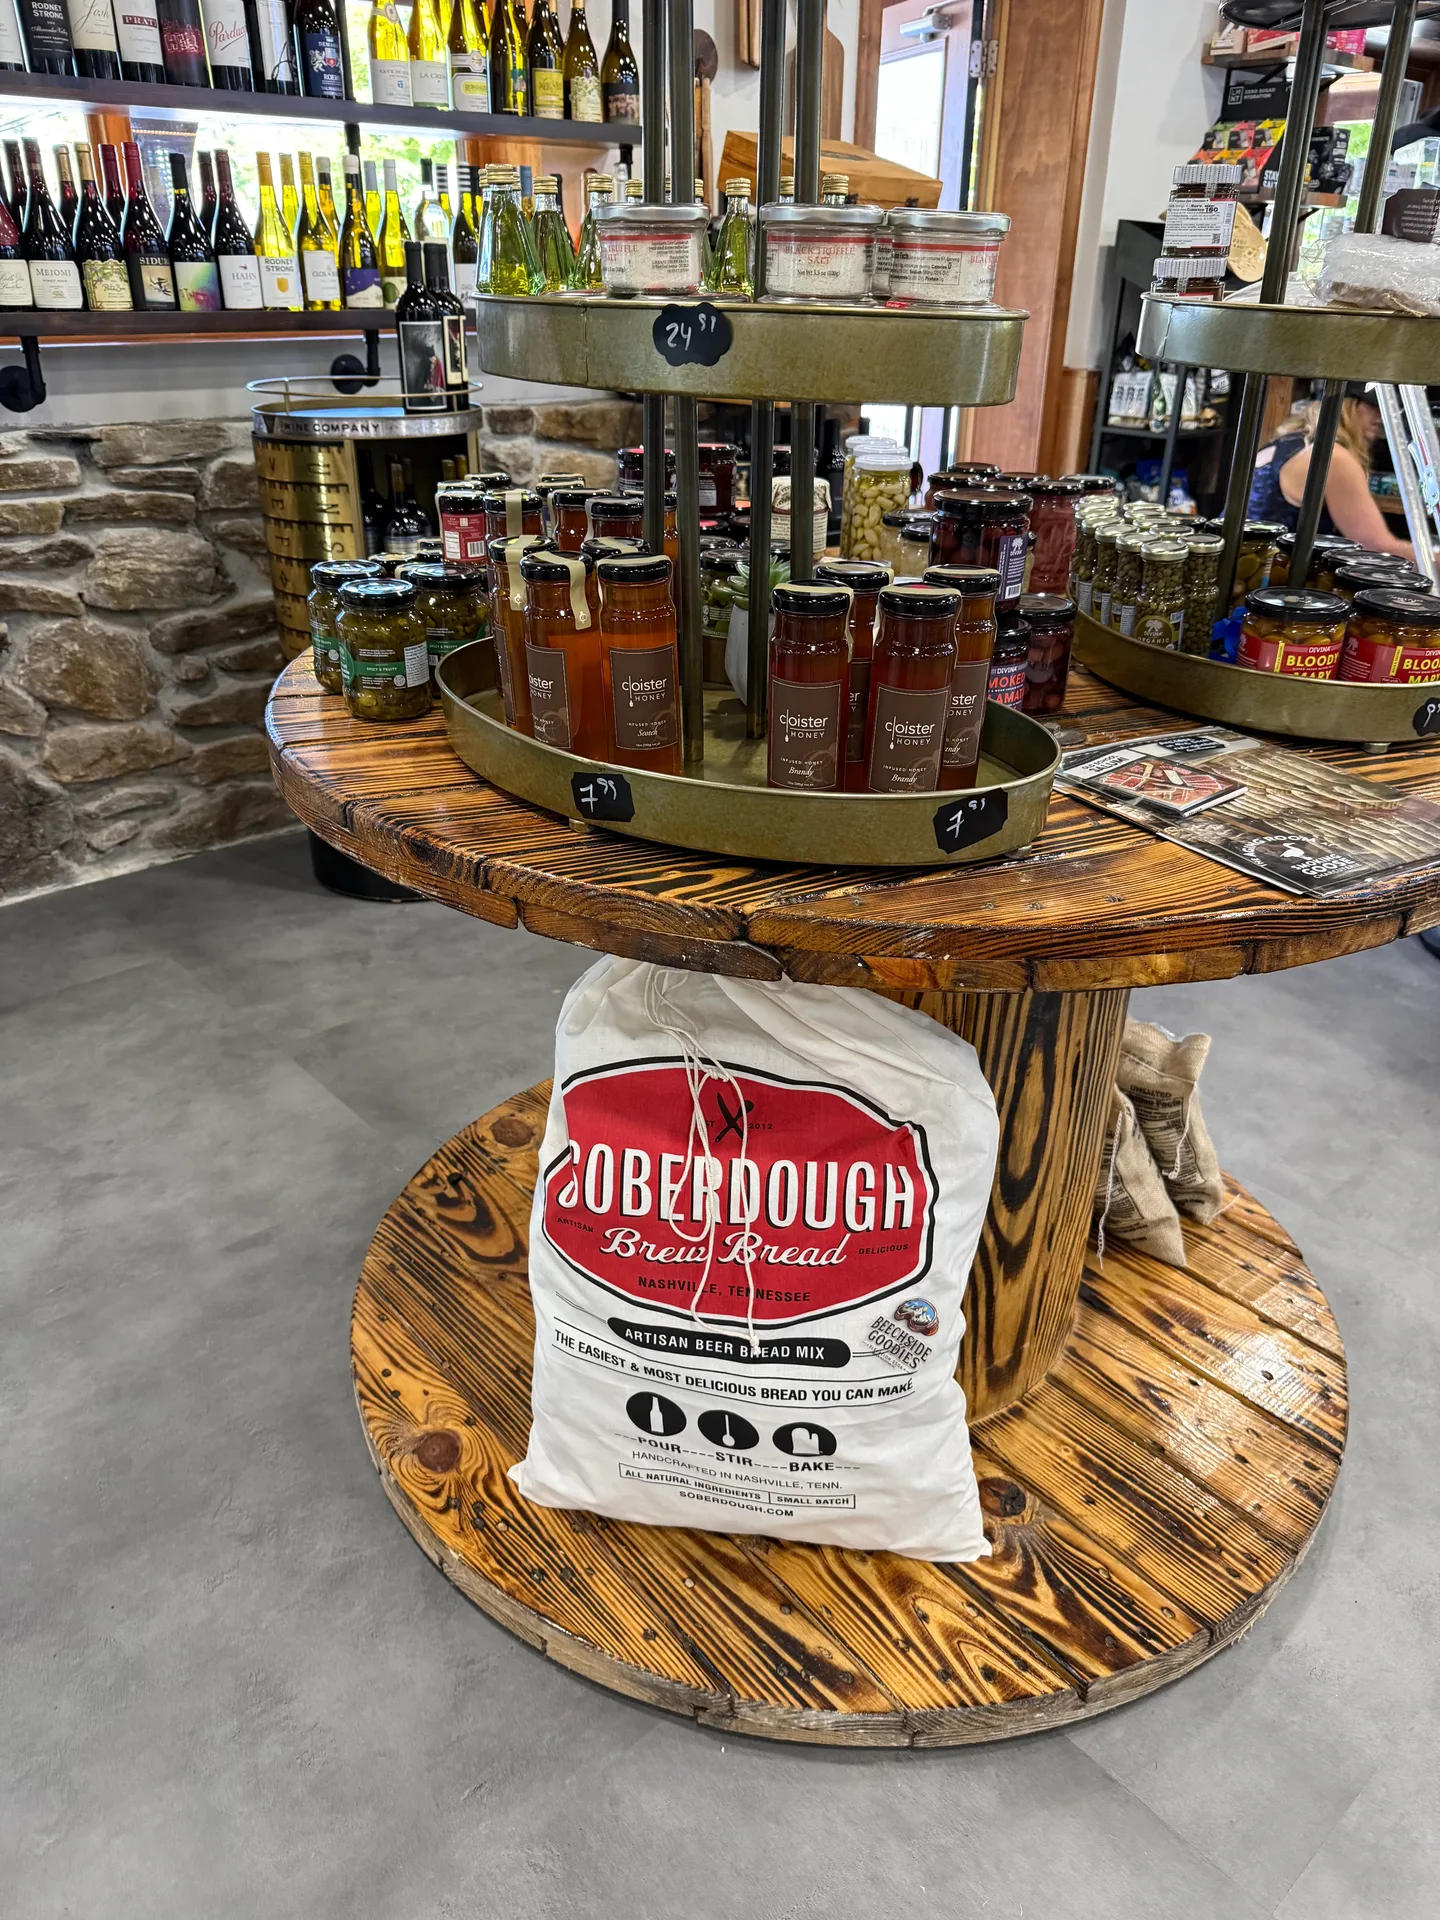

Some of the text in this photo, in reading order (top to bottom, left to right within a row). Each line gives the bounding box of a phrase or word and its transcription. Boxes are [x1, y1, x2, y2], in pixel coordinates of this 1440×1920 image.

[32, 1, 62, 11] RODNEY
[33, 10, 64, 19] STRONG
[209, 20, 246, 50] Parduc
[1264, 169, 1279, 181] STAY
[1262, 181, 1278, 189] SALT
[608, 245, 638, 253] TRUFFLE
[785, 246, 856, 255] BLACK TRUFFLE
[264, 258, 294, 266] RODNEY
[807, 256, 831, 265] SALT
[36, 268, 72, 277] MEIOMI
[266, 265, 294, 273] STRONG
[232, 272, 257, 281] HAHN
[665, 322, 692, 351] 24
[312, 423, 380, 433] COMPANY
[1137, 636, 1170, 644] ORGANIC
[1286, 652, 1340, 667] BLOODY
[1402, 659, 1440, 670] BLOO
[529, 674, 553, 691] oister
[989, 672, 1026, 688] MOKED
[622, 676, 667, 698] cloister
[634, 692, 666, 702] HONEY
[952, 693, 978, 706] ster
[948, 708, 974, 717] ONEY
[779, 709, 828, 734] cloister
[637, 724, 658, 737] Scotch
[790, 731, 825, 739] HONEY
[885, 716, 935, 741] cloister
[896, 738, 931, 746] HONEY
[944, 746, 961, 755] andy
[780, 757, 802, 765] INFUSED
[788, 766, 814, 778] Brandy
[882, 764, 906, 773] INFUSED
[891, 773, 917, 785] Brandy
[579, 783, 599, 813] 7
[946, 809, 965, 839] 7
[1241, 838, 1265, 858] AGING
[1263, 835, 1315, 843] ROOM
[1290, 853, 1342, 870] SMOKING
[1301, 856, 1356, 876] GOOSE
[1129, 1084, 1172, 1098] UNSALTED
[705, 1120, 773, 1130] ST 2012
[557, 1139, 914, 1233] SOBERDOUGH
[557, 1217, 909, 1256] ARTISAN DELICIOUS
[600, 1227, 848, 1269] Brew Bread
[638, 1275, 811, 1303] NASHVILLE, TENNESSEE
[625, 1328, 688, 1348] ARTISAN
[696, 1337, 733, 1355] BEER
[796, 1346, 825, 1360] MIX
[871, 1315, 933, 1363] BEECHSIDE
[868, 1329, 920, 1369] GOODIES
[554, 1329, 913, 1401] THE EASIEST & MOST DELICIOUS BREAD YOU CAN MAKE
[638, 1436, 835, 1473] POUR STIR BAKE
[632, 1450, 843, 1490] HANDCRAFTED IN NASHVILLE, TENN.
[625, 1469, 849, 1505] ALL NATURAL INGREDIENTS SMALL BATCH
[679, 1490, 794, 1517] SOBERDOUGH.COM
